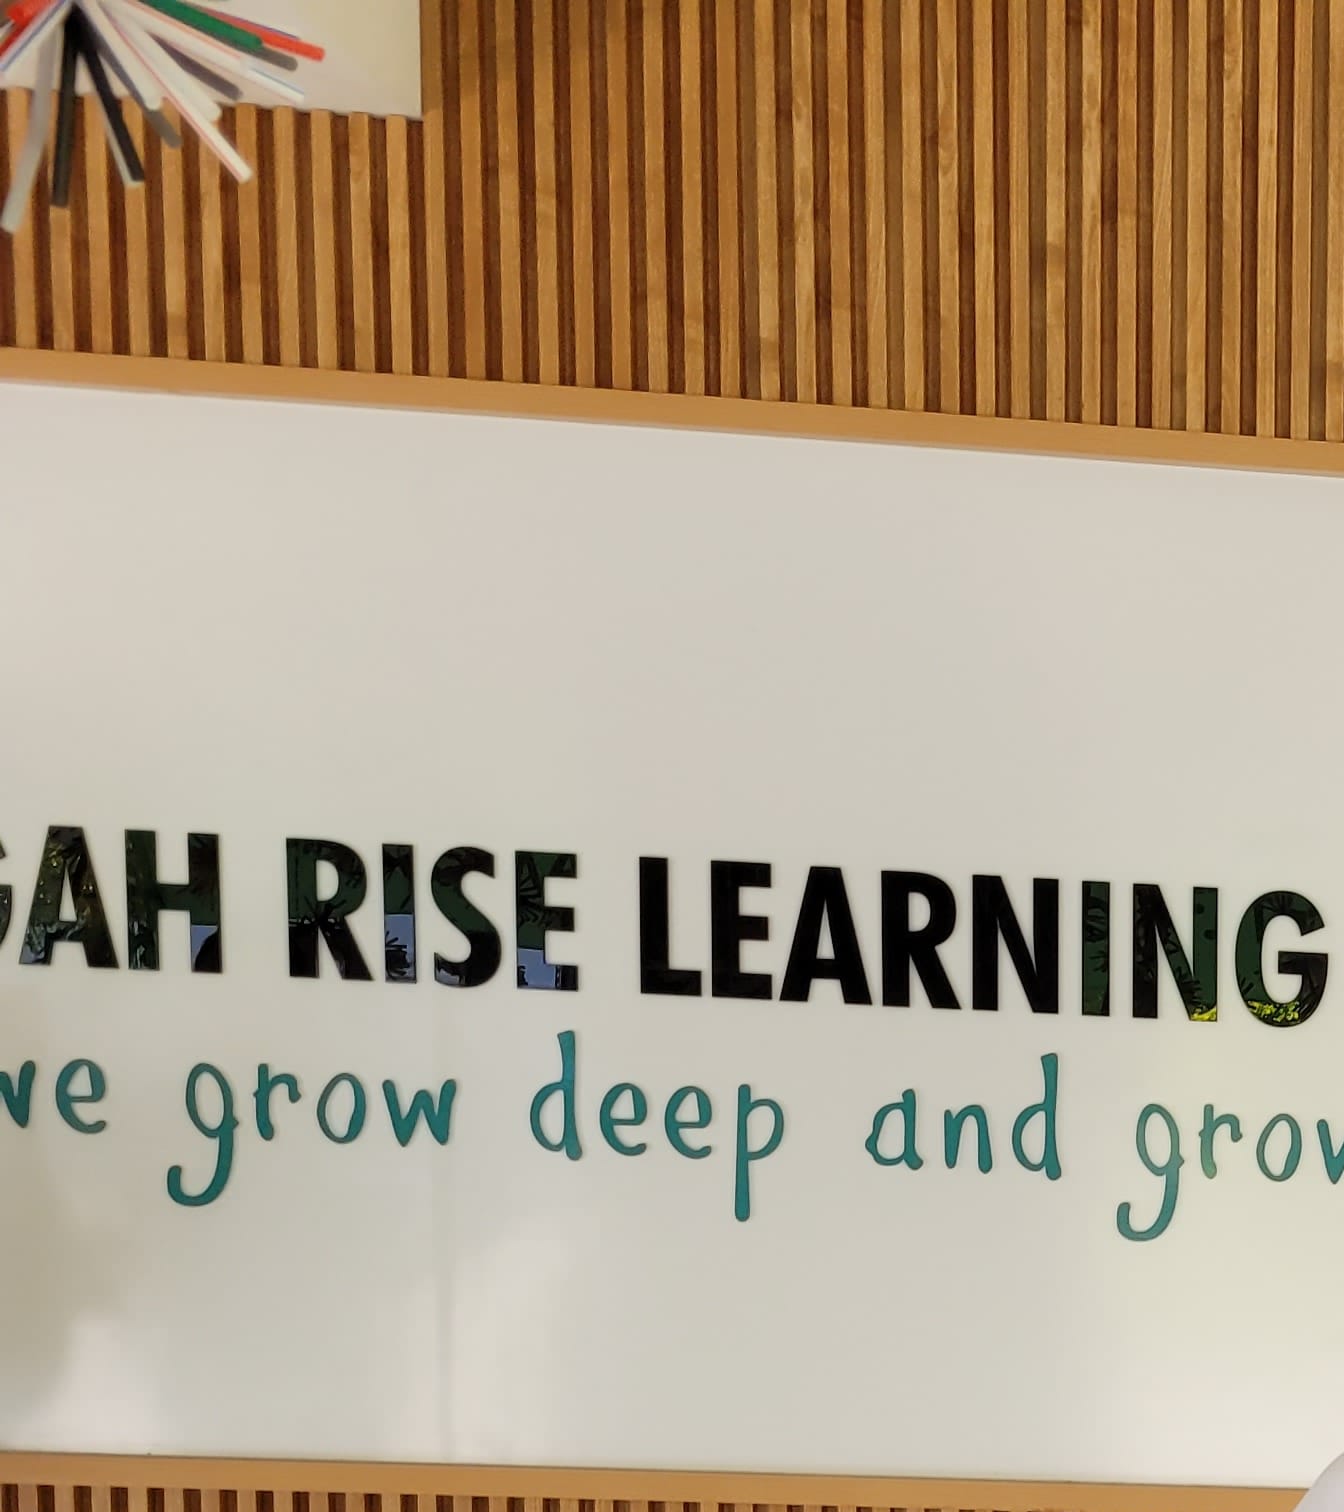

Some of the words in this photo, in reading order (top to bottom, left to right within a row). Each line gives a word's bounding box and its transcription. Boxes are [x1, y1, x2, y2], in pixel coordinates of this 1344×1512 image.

[0, 825, 222, 974] AH
[286, 836, 579, 992] RISE
[638, 856, 1328, 1028] LEARNING
[166, 1061, 457, 1207] grow
[530, 1030, 785, 1222] deep
[865, 1053, 1061, 1182] and
